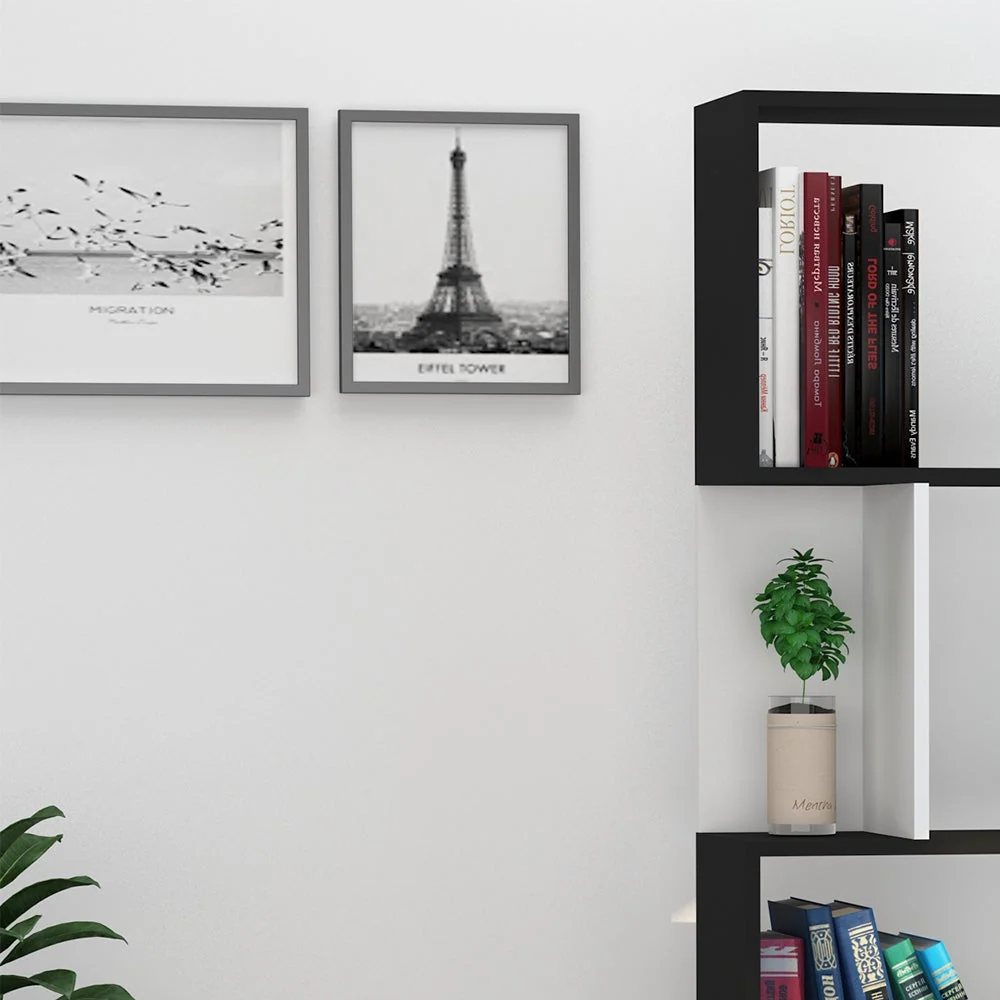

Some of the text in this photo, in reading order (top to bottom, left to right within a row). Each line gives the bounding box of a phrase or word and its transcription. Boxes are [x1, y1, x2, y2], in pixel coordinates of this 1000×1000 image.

[89, 306, 175, 315] MIGRATION
[418, 363, 506, 375] EIFFEL TOWER
[942, 983, 963, 998] СЕРГЕЙ
